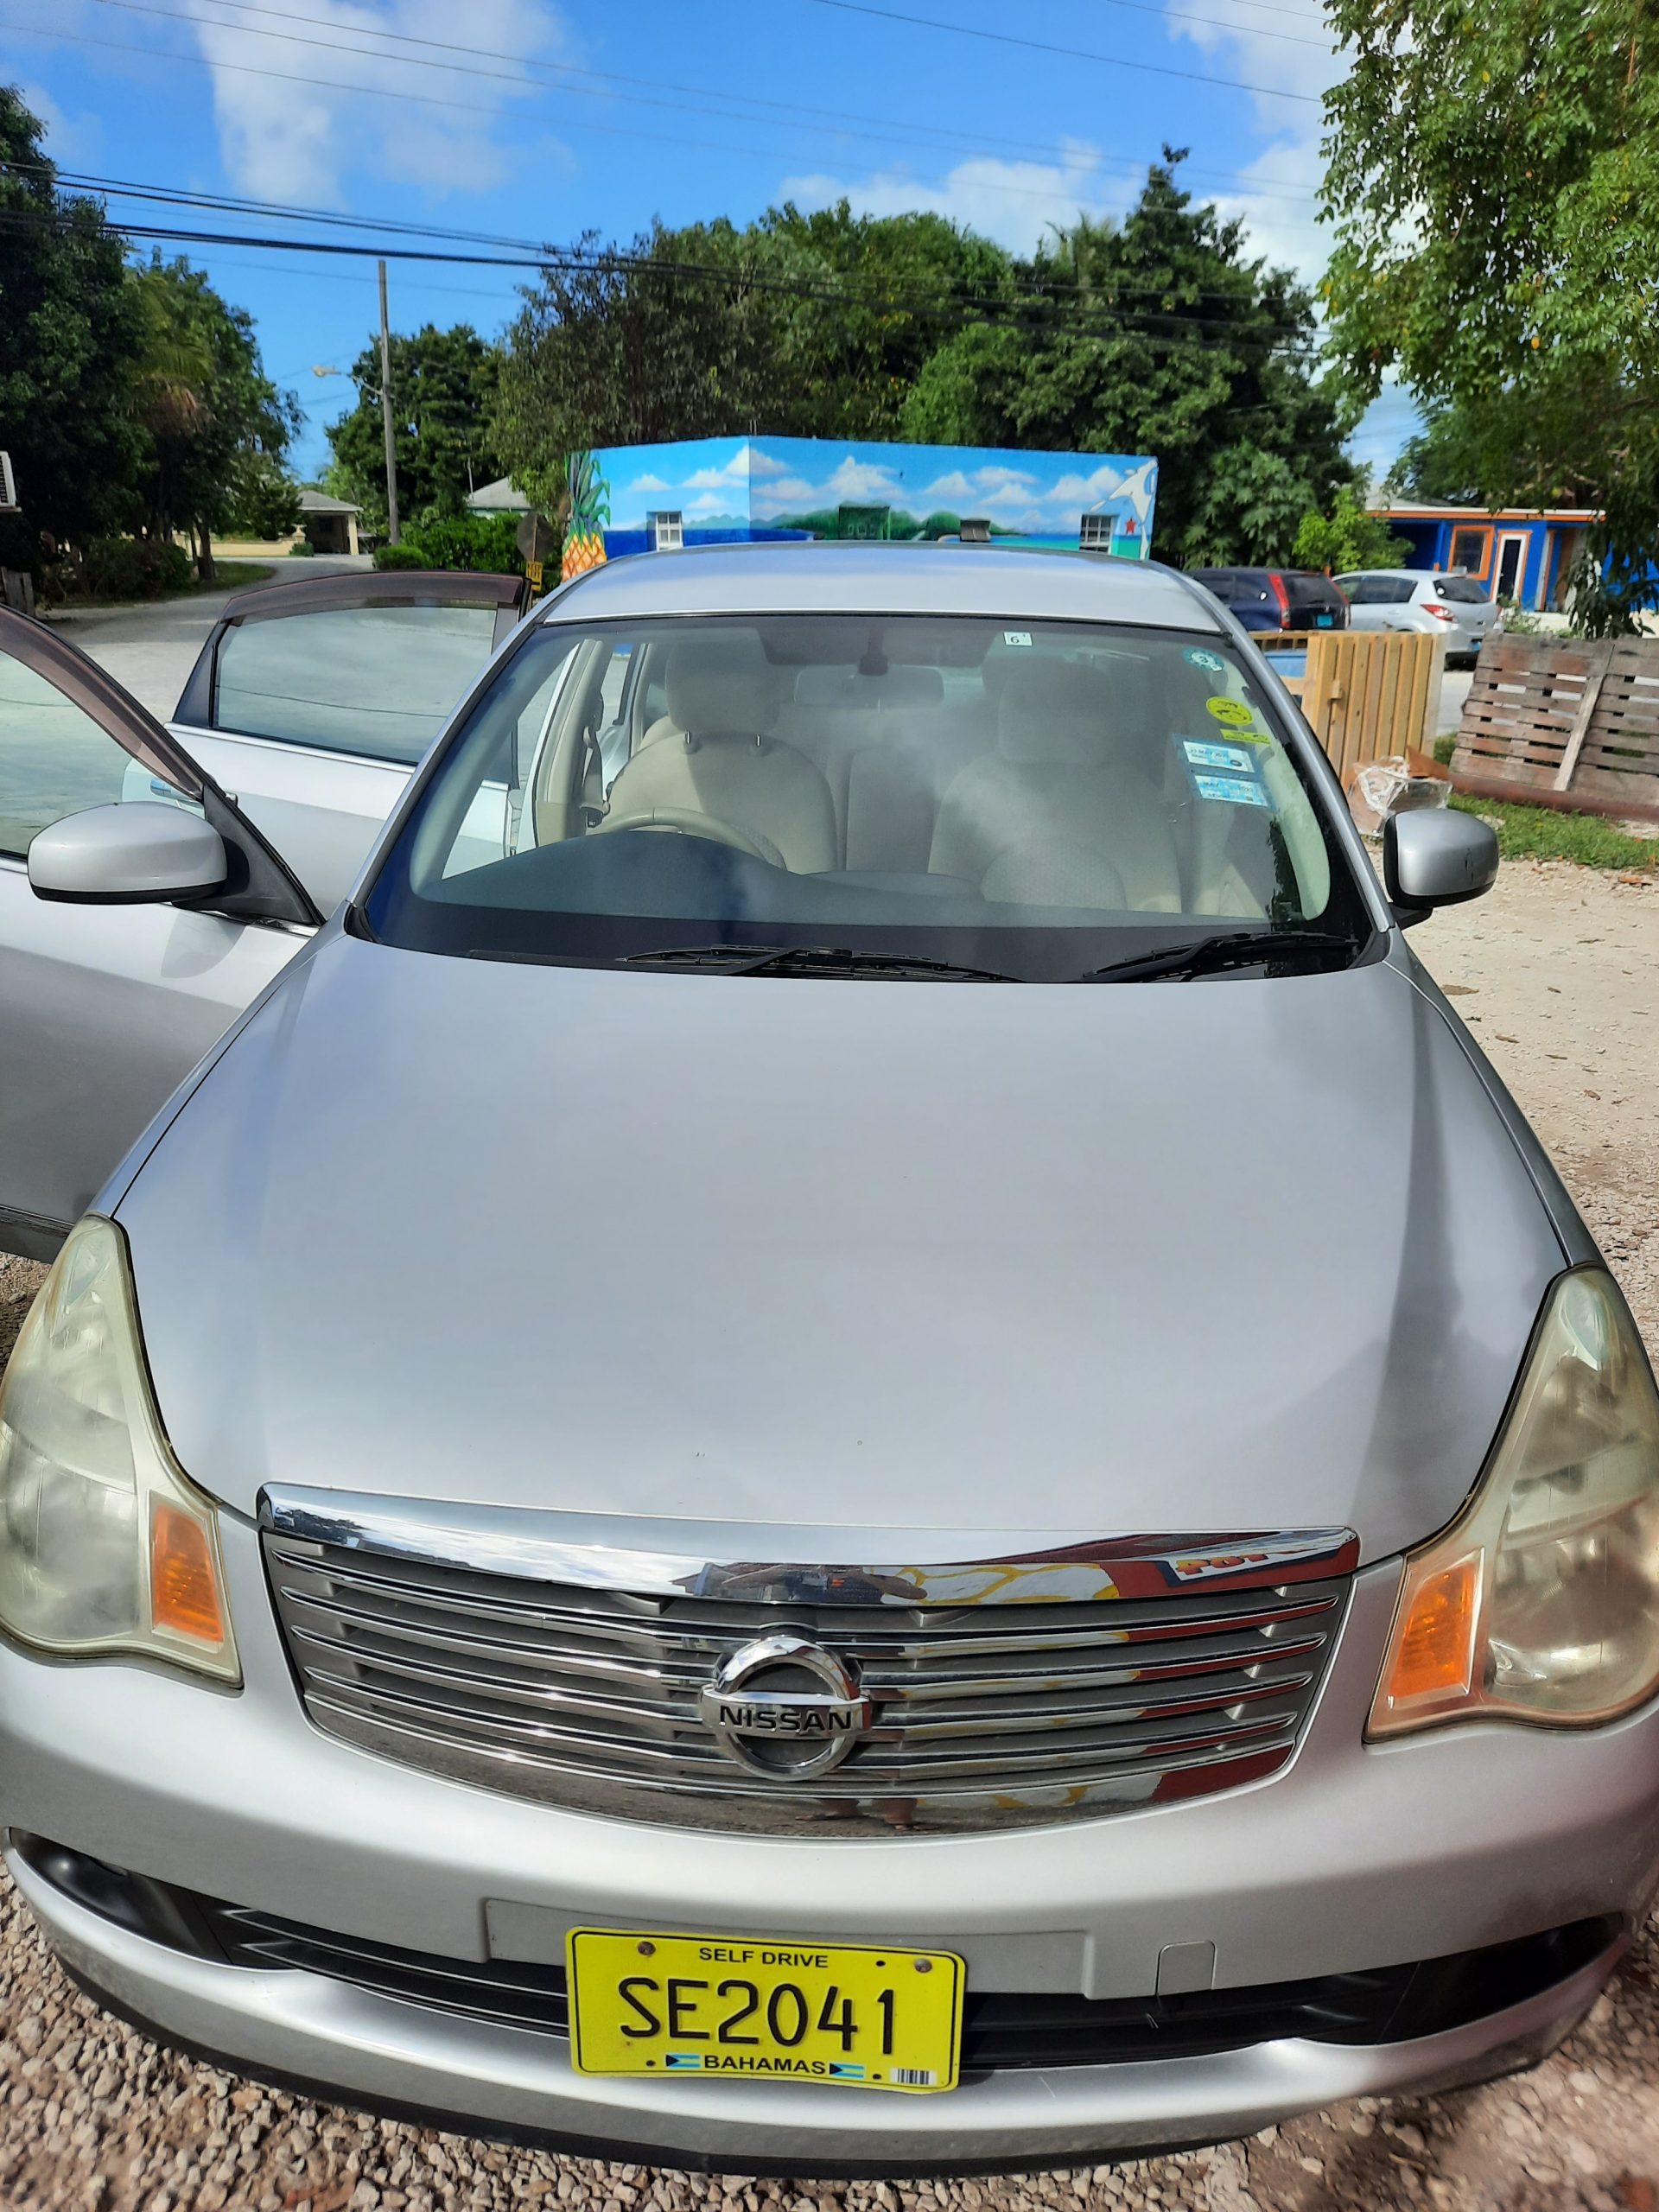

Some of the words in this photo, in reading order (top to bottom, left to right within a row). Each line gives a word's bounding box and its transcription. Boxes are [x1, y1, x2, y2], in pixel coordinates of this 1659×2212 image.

[720, 1705, 851, 1731] NISSAN
[698, 1947, 754, 1964] SELF
[760, 1951, 830, 1968] DRIVE
[617, 1976, 894, 2056] SE2041
[703, 2055, 827, 2075] BAHAMAS
